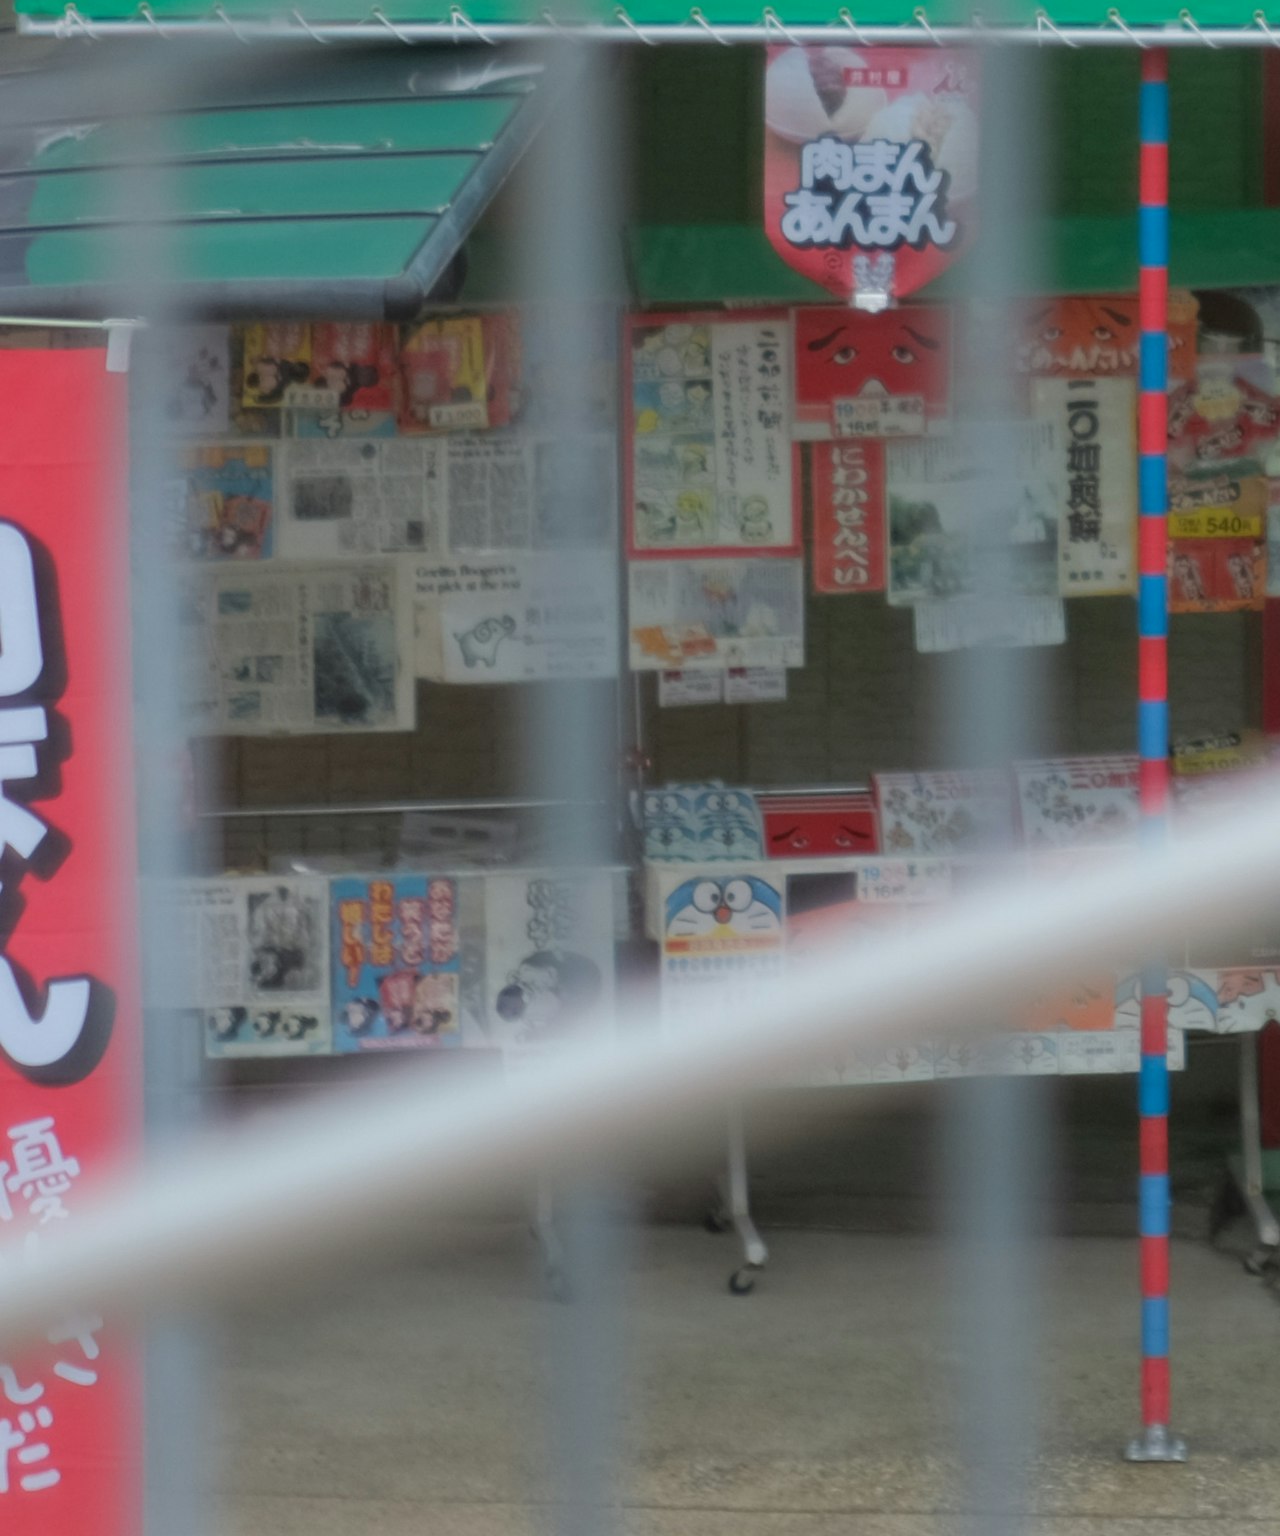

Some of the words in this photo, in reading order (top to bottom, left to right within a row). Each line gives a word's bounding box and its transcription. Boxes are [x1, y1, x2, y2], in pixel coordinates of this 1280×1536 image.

[802, 137, 943, 194] 肉まん
[781, 190, 956, 245] あんまん
